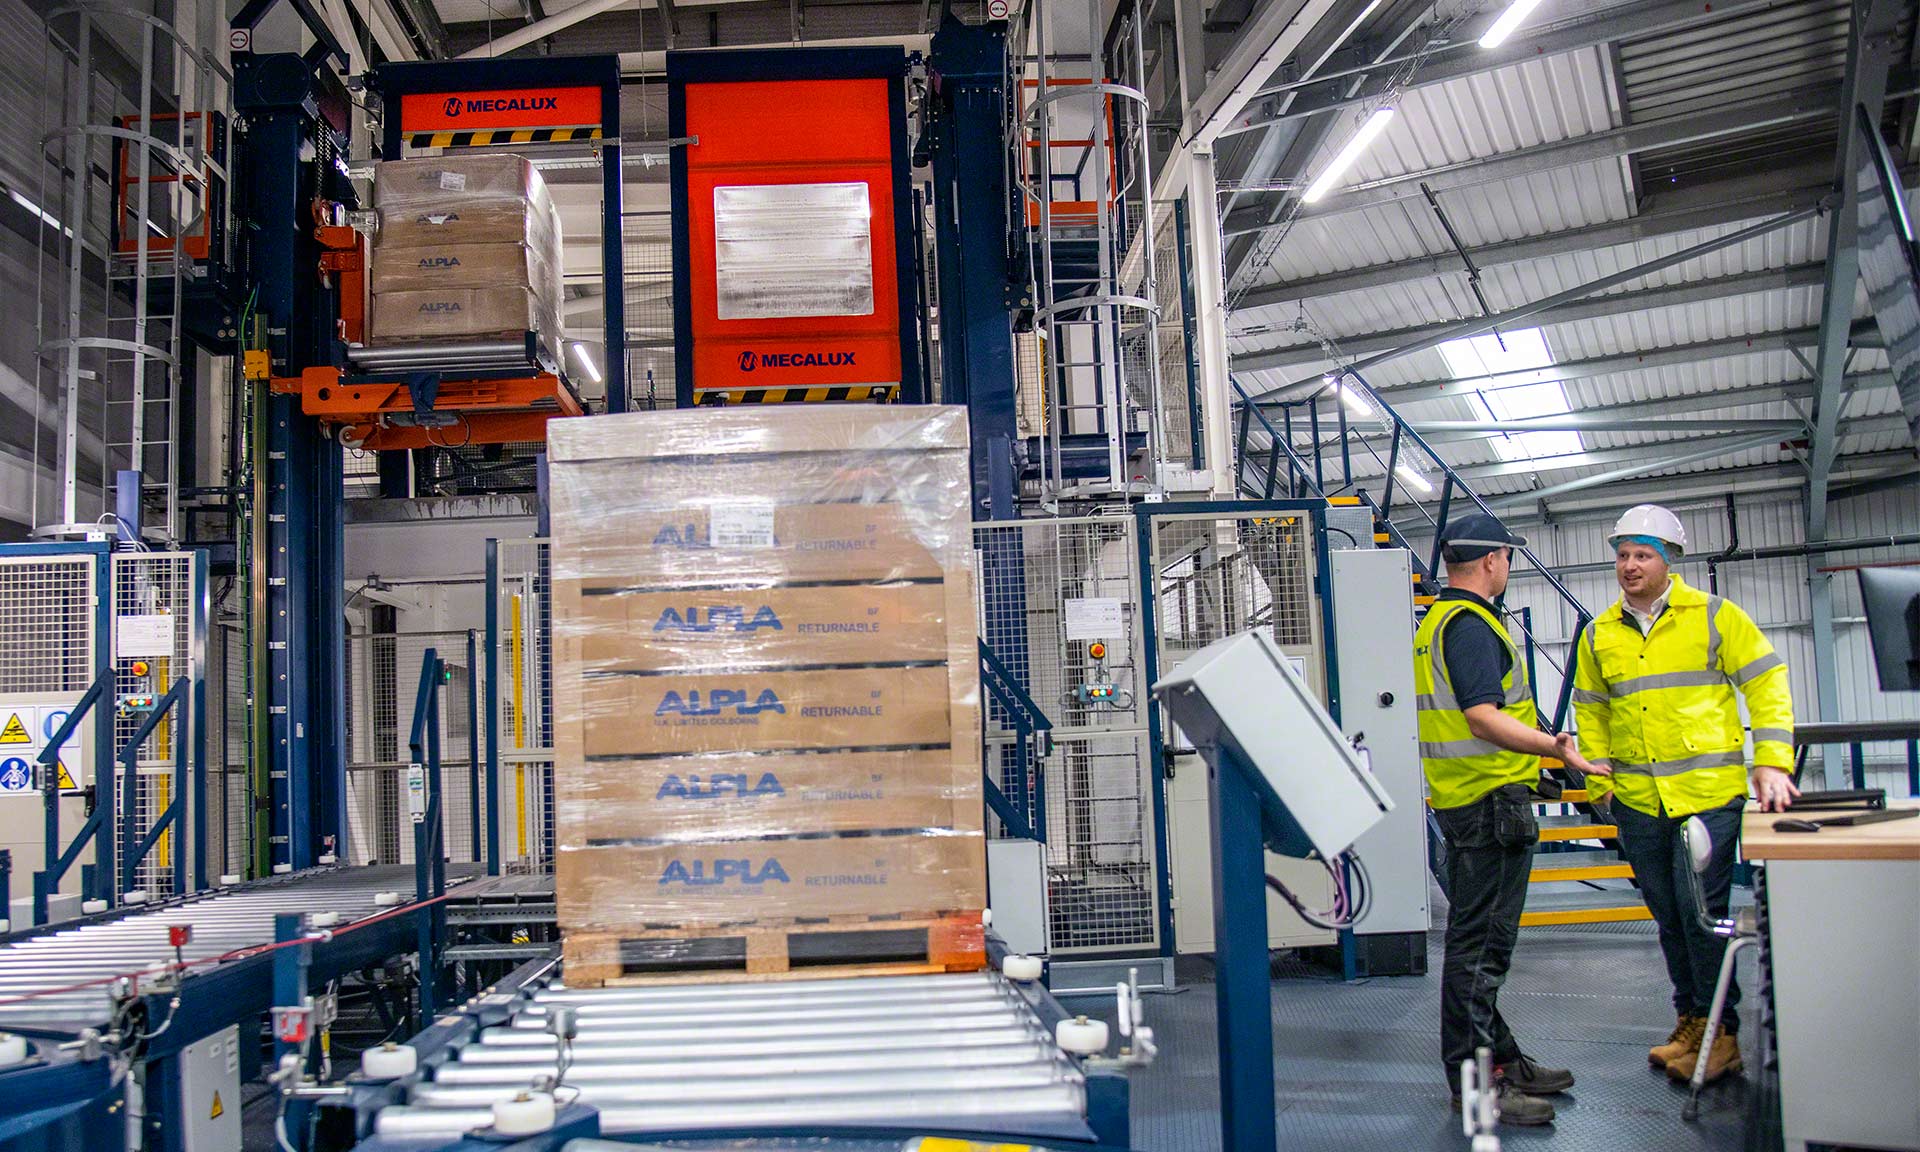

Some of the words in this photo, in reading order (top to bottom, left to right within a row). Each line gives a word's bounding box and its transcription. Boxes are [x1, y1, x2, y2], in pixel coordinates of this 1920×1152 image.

[467, 97, 558, 112] MECALUX
[417, 256, 461, 267] ALPLA
[418, 302, 461, 312] ALPLA
[762, 352, 856, 367] MECALUX
[653, 605, 783, 632] ALPLA
[798, 622, 880, 633] RETURNABLE
[655, 688, 786, 716] ALPLA
[801, 705, 882, 717] RETURNABLE
[656, 772, 786, 800] ALPLA
[658, 857, 791, 886] ALPLA
[805, 873, 888, 887] RETURNABLE
